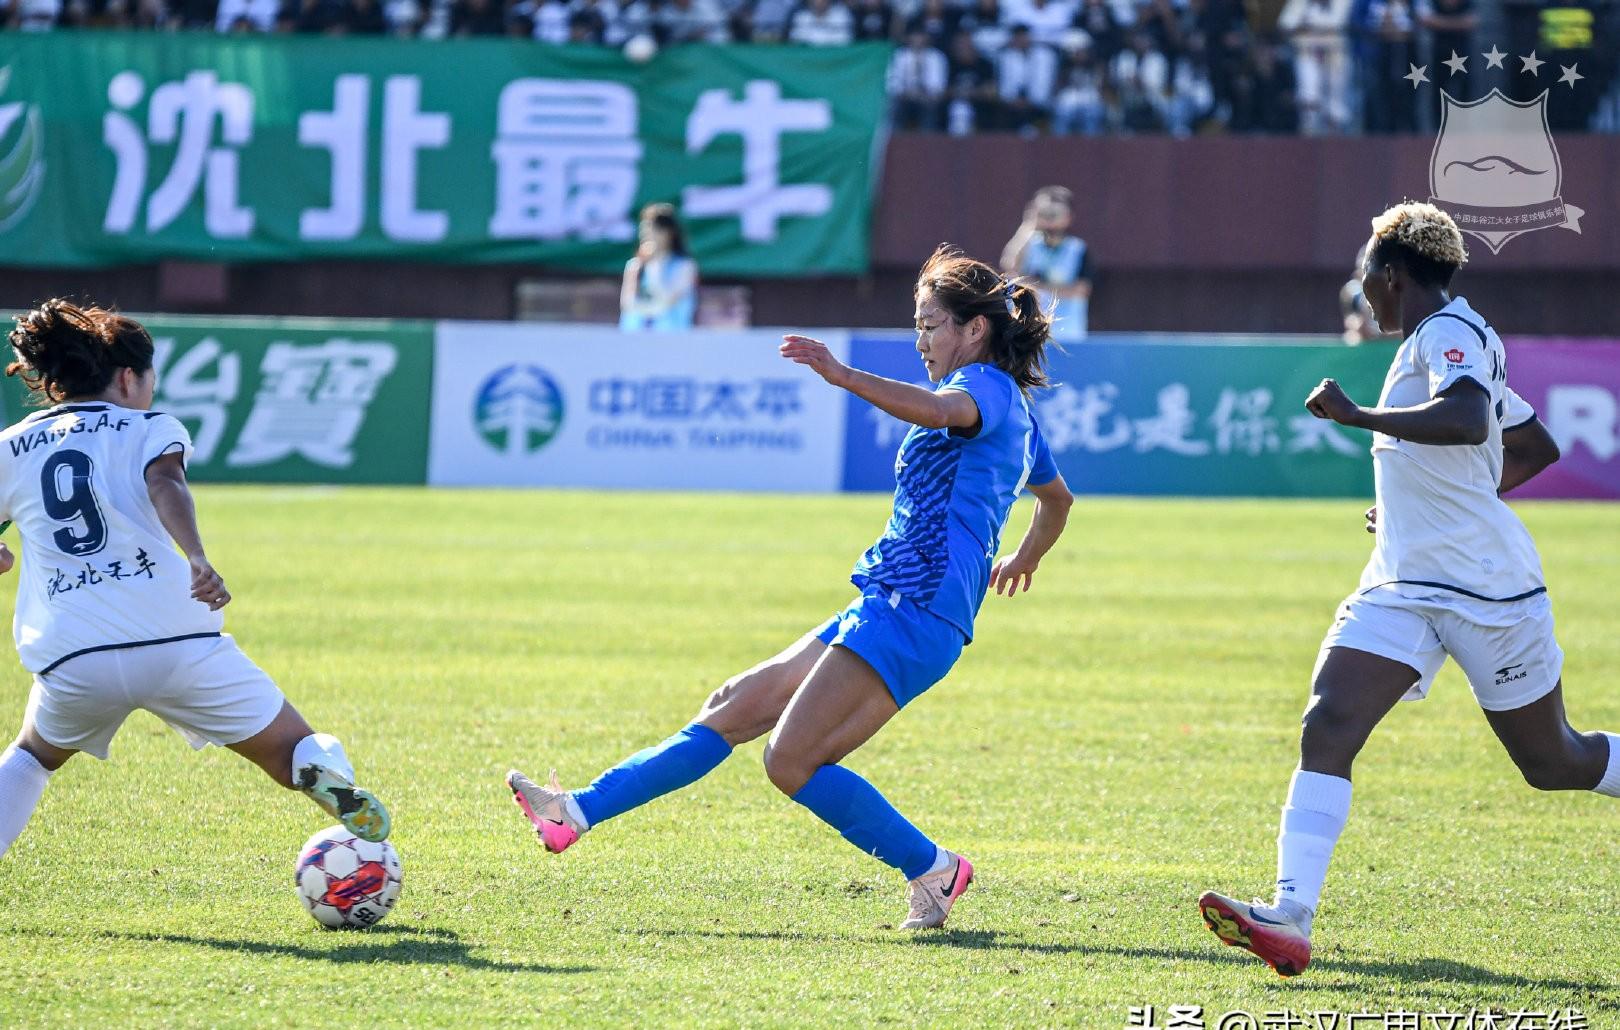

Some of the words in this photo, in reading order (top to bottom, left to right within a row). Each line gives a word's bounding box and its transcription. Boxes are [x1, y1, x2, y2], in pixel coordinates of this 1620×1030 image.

[103, 70, 833, 243] 沈北最牛
[588, 378, 803, 418] 中国太平
[867, 382, 1362, 456] 就是保太
[586, 428, 677, 449] CHINA
[688, 429, 803, 450] TAIPING
[41, 449, 108, 556] 9
[1495, 671, 1527, 686] SUNAIS
